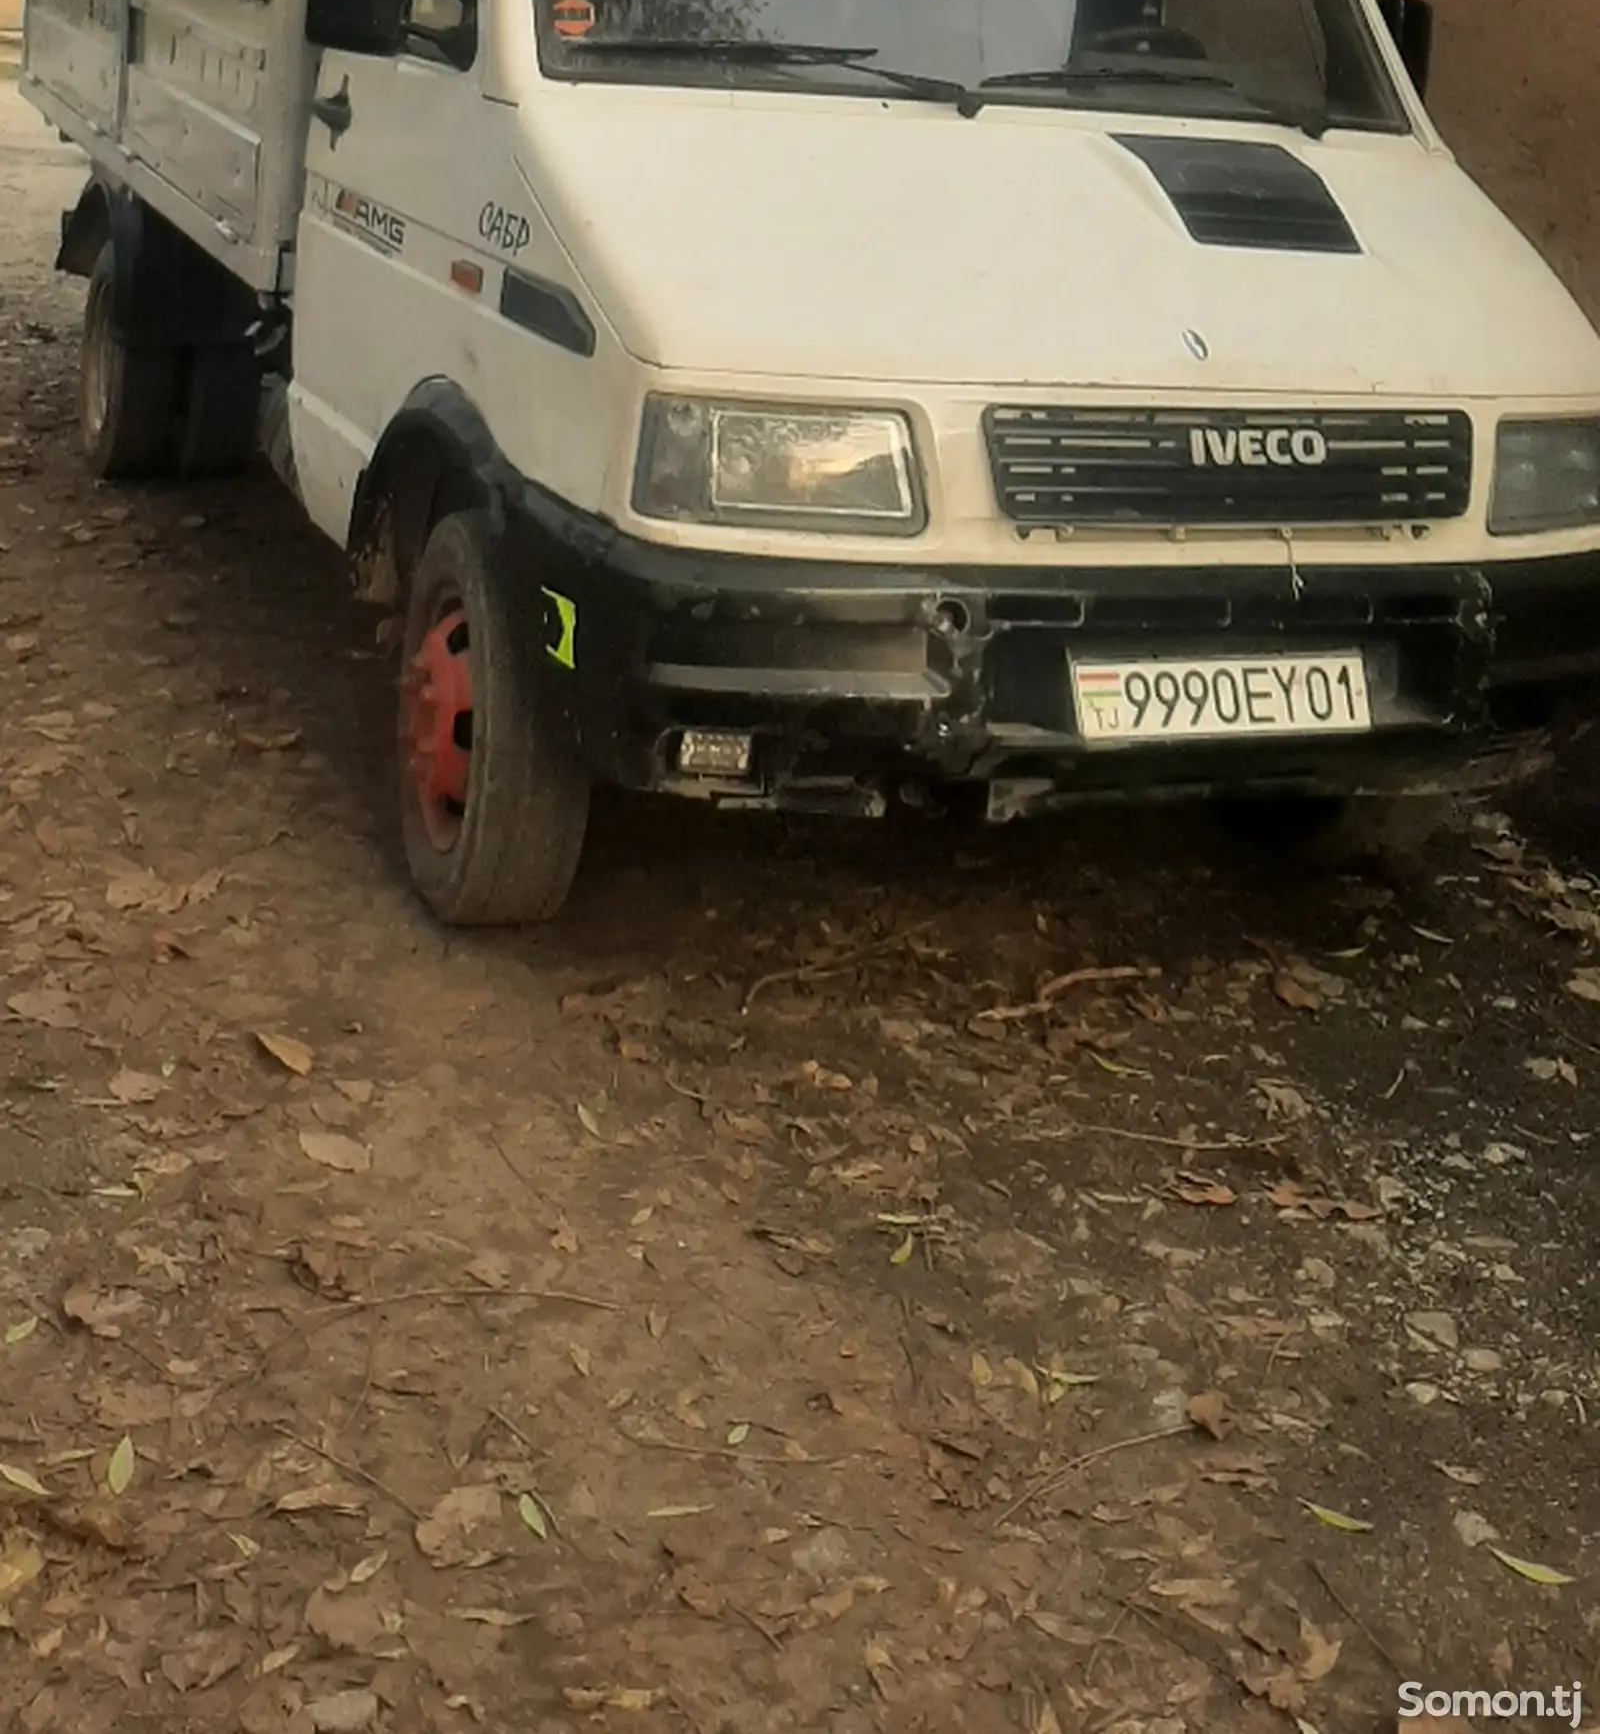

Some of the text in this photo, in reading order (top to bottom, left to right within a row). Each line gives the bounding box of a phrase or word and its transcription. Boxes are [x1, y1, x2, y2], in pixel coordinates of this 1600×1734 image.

[356, 199, 405, 244] AMG
[478, 201, 530, 257] САБР
[1189, 428, 1328, 467] IVECO
[1093, 707, 1120, 730] TJ
[1124, 664, 1357, 729] 9990EY01
